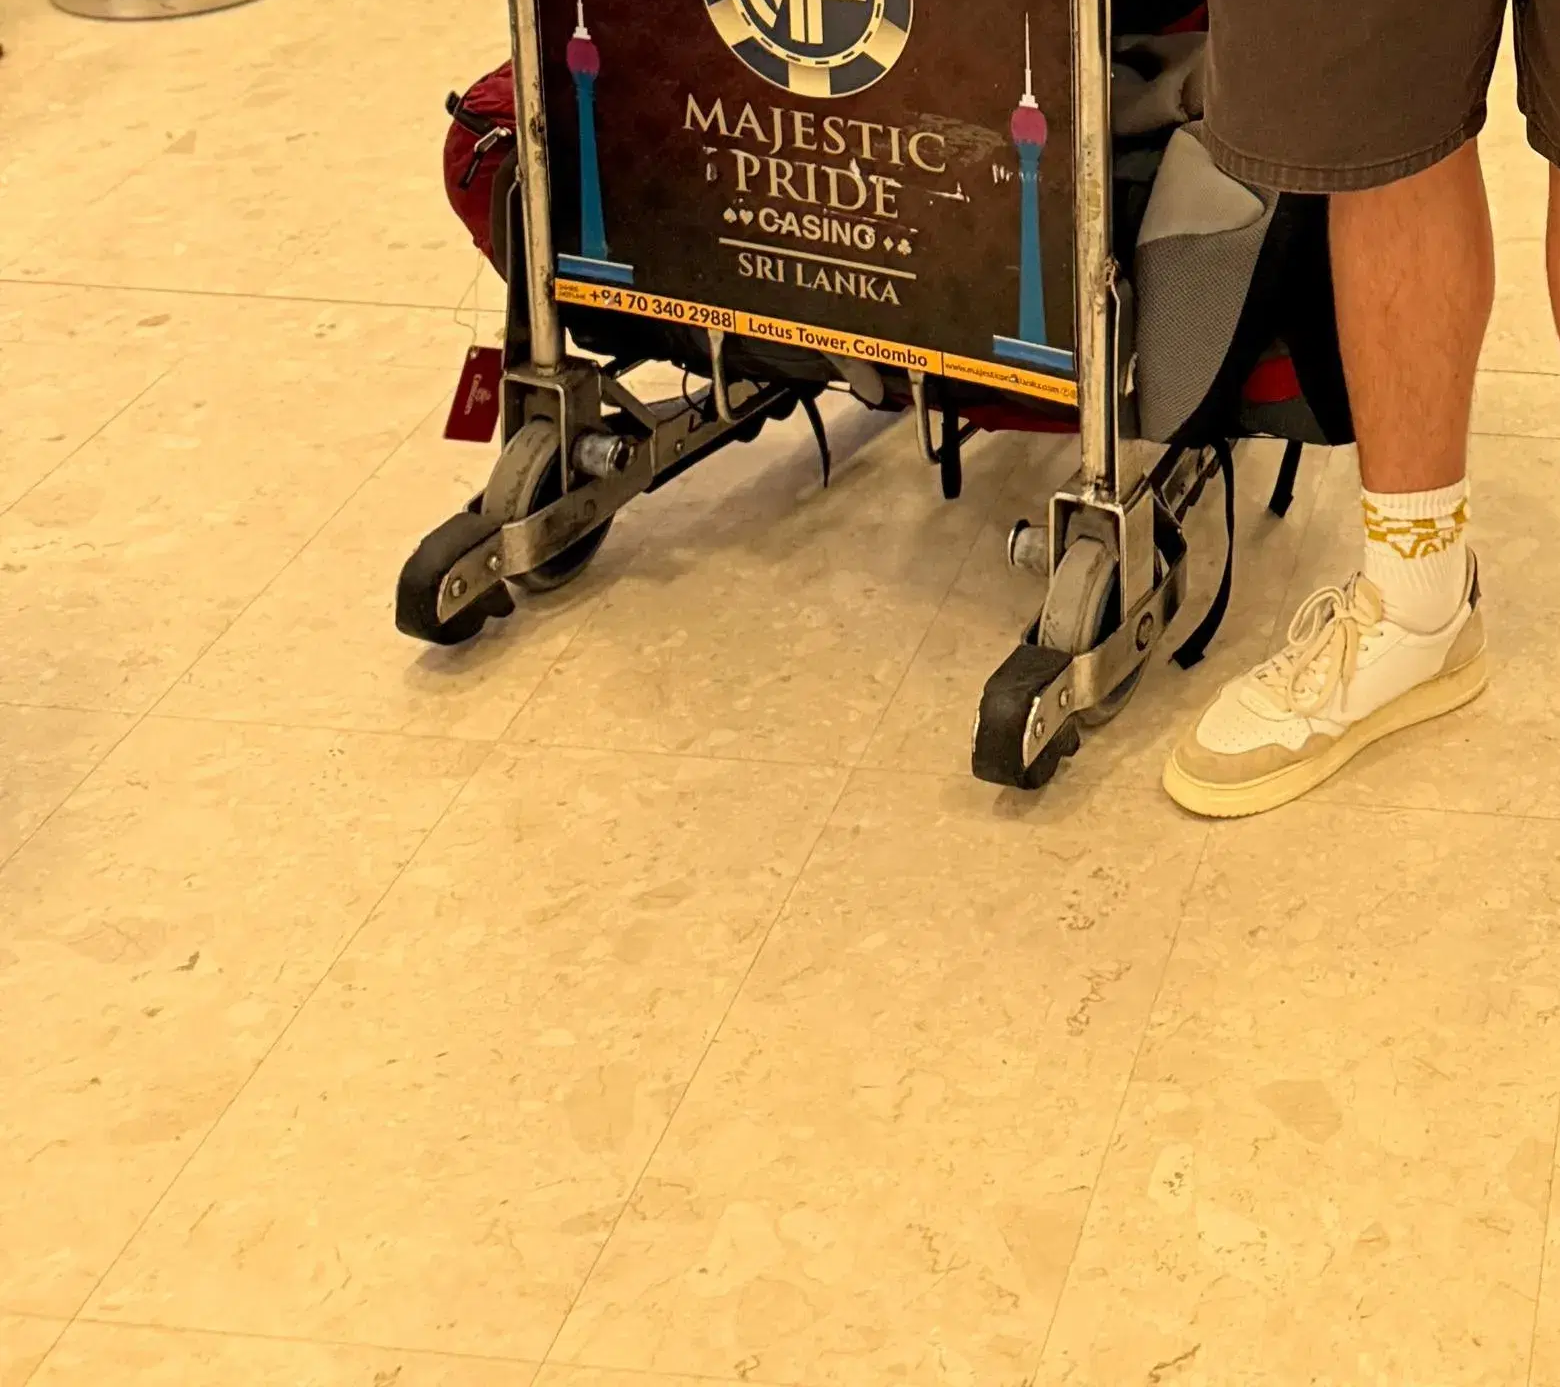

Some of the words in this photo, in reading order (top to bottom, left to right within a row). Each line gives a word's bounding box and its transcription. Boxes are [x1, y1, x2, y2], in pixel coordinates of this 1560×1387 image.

[682, 93, 946, 173] MAJESTIC
[730, 149, 898, 218] PRIDE
[758, 207, 876, 250] CASINO
[738, 252, 785, 283] SRI
[796, 262, 901, 305] LANKA
[590, 289, 622, 307] +94
[626, 293, 648, 312] 70
[652, 299, 684, 318] 340
[689, 306, 732, 328] 2988
[749, 318, 792, 340] Lotus
[796, 327, 850, 354] Tower,
[854, 339, 928, 367] Colombo
